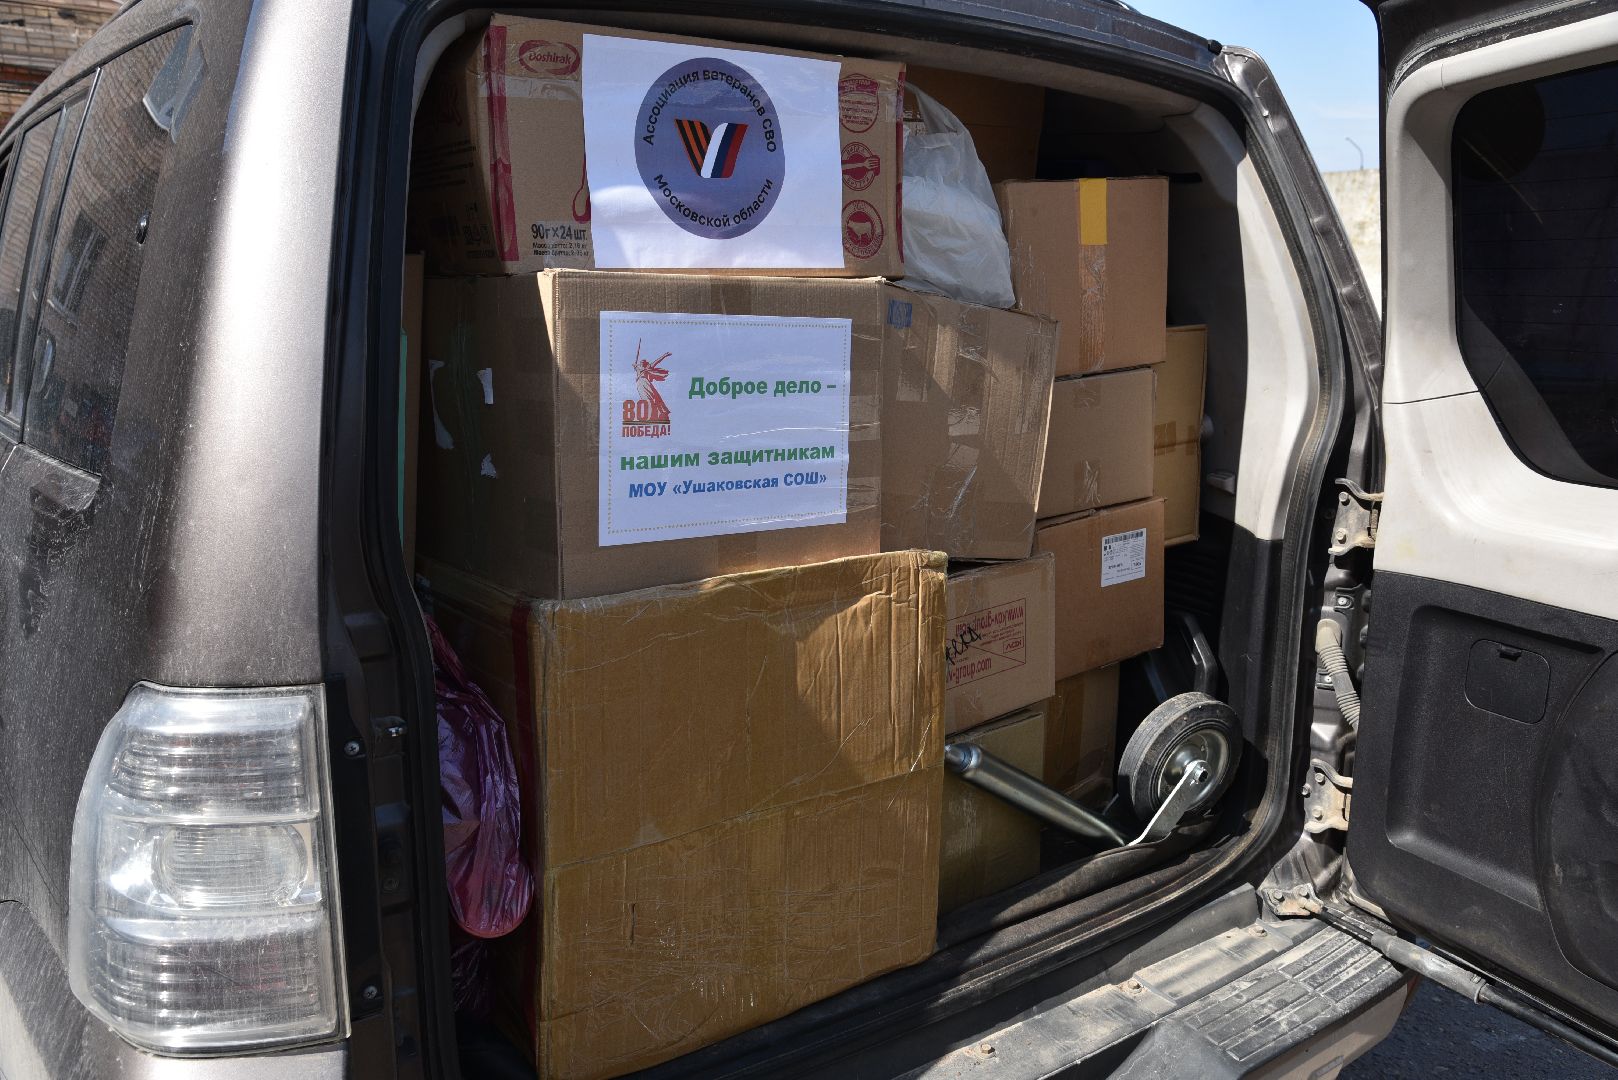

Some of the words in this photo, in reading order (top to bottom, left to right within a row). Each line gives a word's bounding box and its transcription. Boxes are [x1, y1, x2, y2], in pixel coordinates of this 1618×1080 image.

[643, 71, 700, 146] Ассоциация
[702, 69, 766, 117] ветеранов
[762, 118, 777, 153] СВО
[653, 173, 731, 228] Московской
[732, 178, 773, 225] области
[688, 376, 768, 400] Доброе
[773, 379, 822, 398] дело
[622, 399, 649, 422] 80
[622, 424, 671, 439] ПОБЕДА!
[620, 452, 700, 471] нашим
[707, 445, 835, 467] защитникам
[629, 481, 667, 498] МОУ
[672, 475, 779, 494] «Ушаковская
[783, 471, 828, 487] СОШ»
